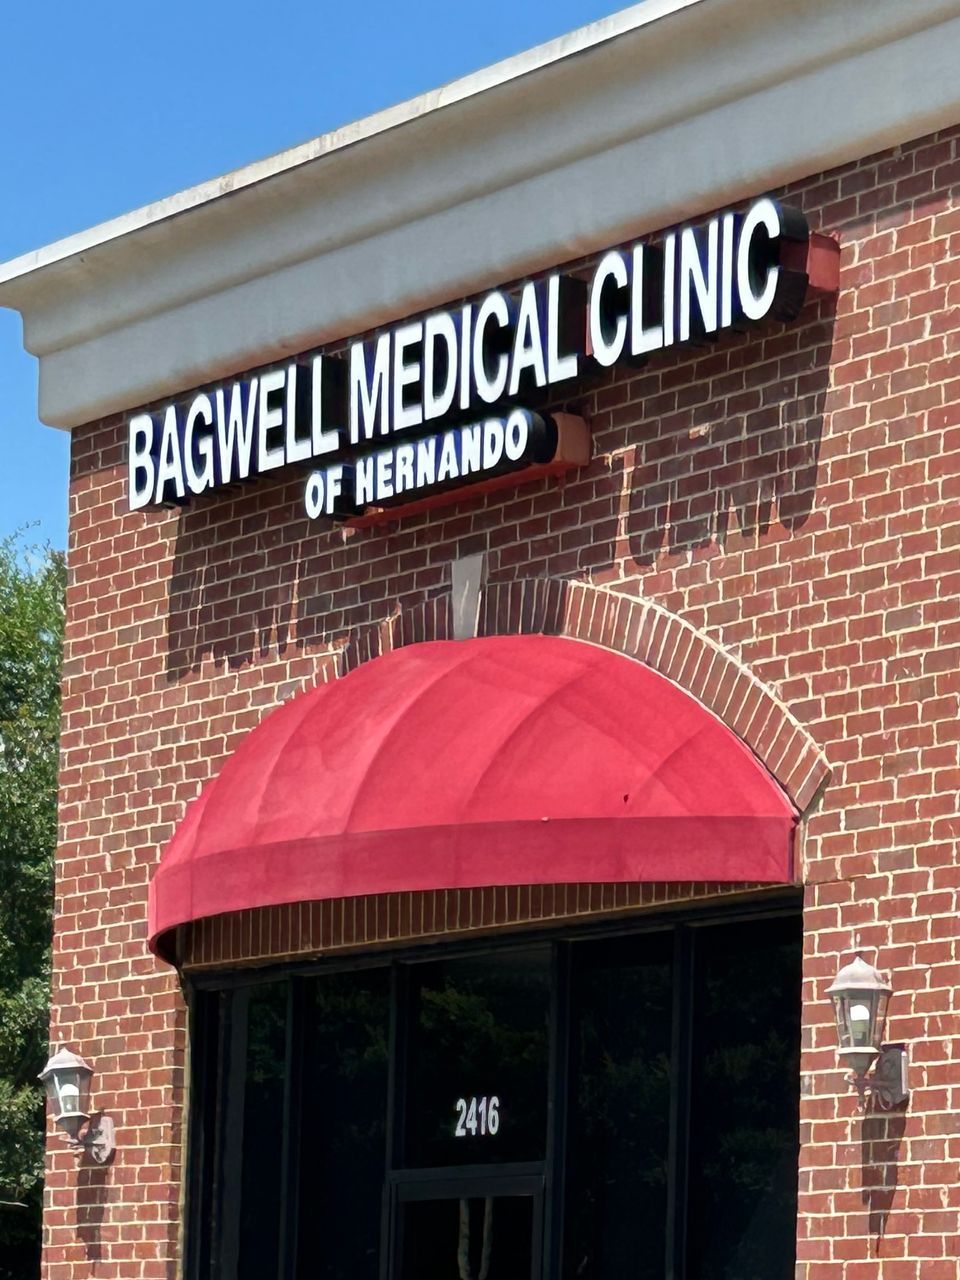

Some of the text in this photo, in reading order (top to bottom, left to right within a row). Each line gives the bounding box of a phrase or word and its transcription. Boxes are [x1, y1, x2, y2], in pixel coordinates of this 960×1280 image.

[129, 198, 781, 511] BAGWELL MEDICAL CLINIC
[304, 409, 529, 520] OF HERNANDO
[454, 1095, 500, 1137] 2416
